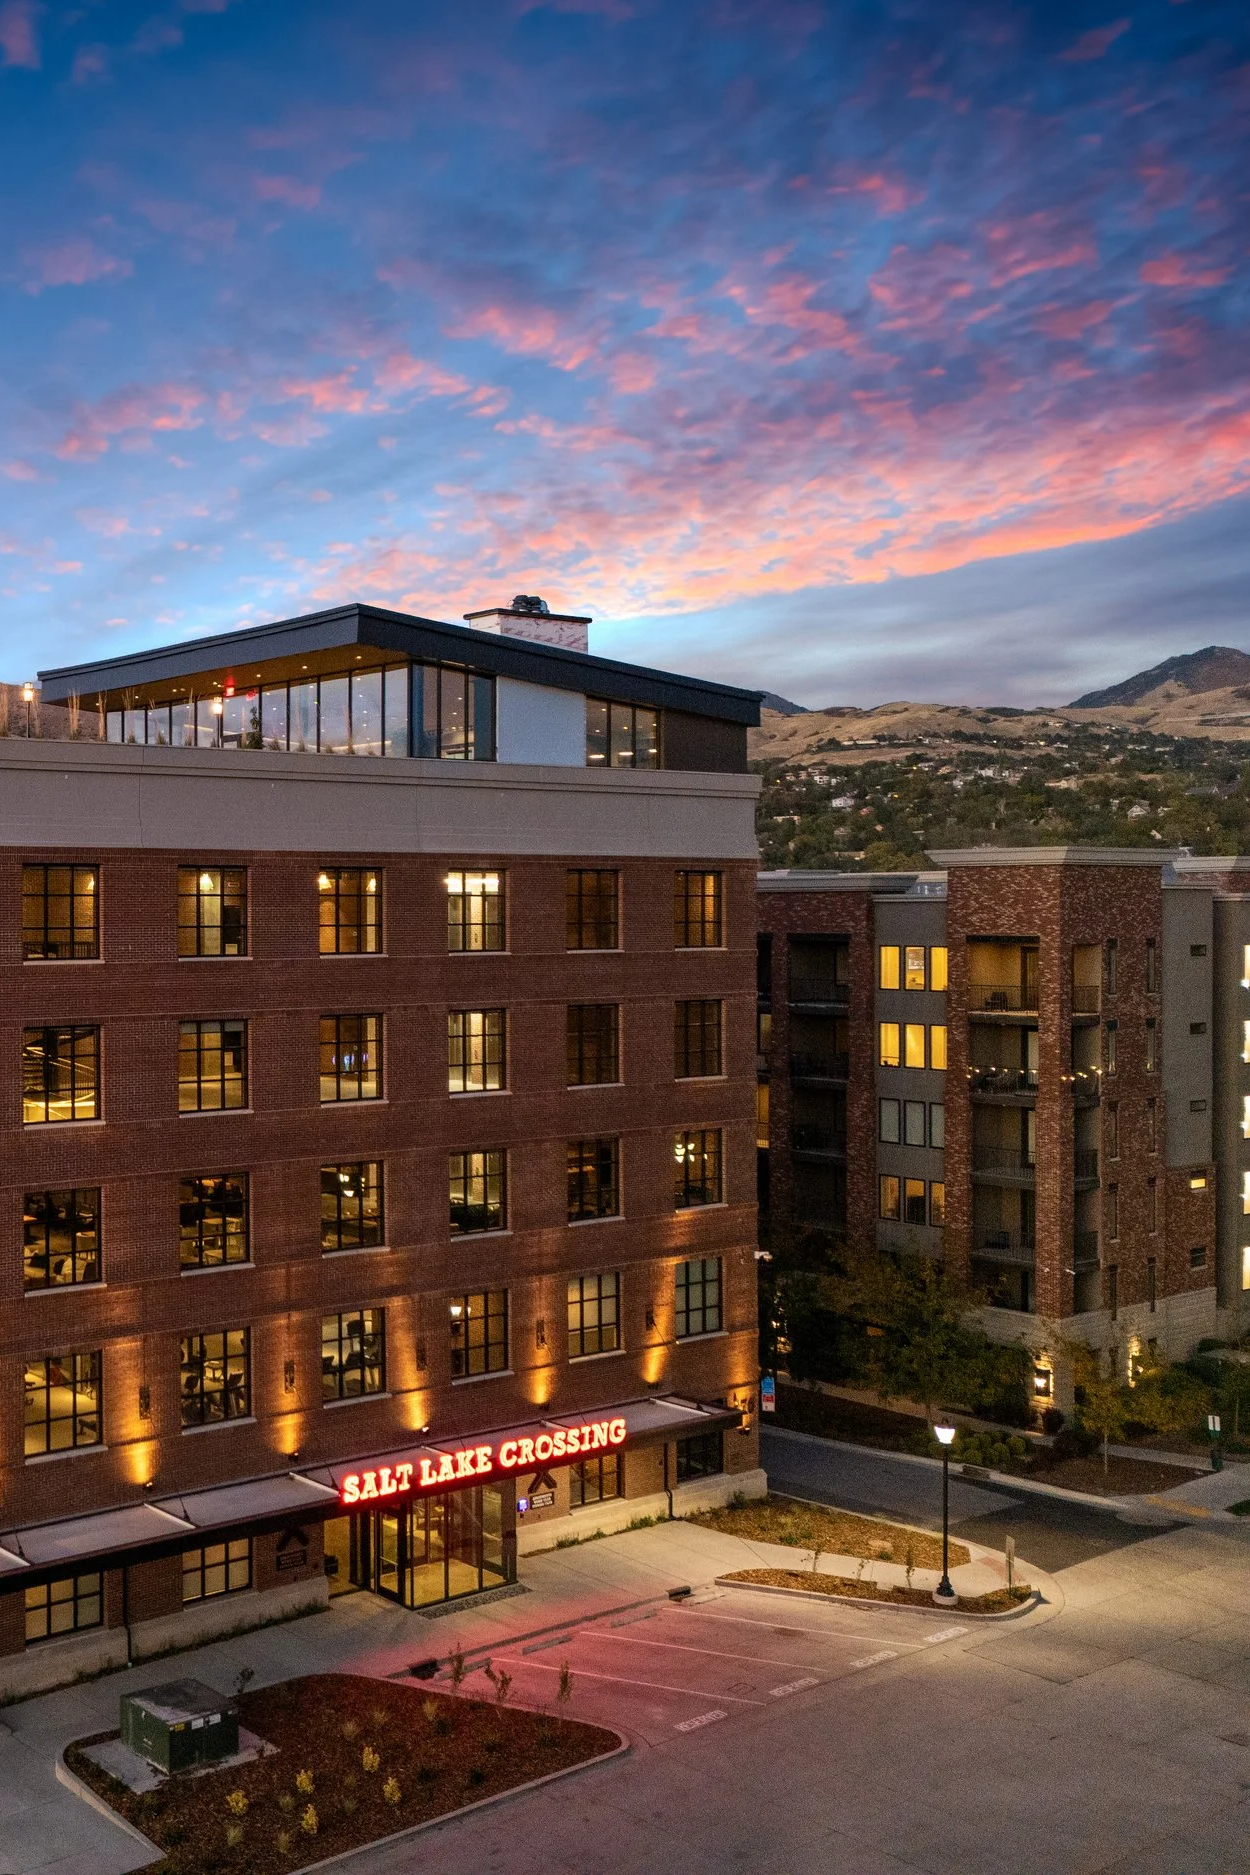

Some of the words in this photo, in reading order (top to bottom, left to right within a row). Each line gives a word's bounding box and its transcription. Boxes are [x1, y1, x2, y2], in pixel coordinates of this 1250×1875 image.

[343, 1463, 413, 1505] SALT
[420, 1445, 492, 1486] LAKE
[499, 1418, 627, 1469] CROSSING
